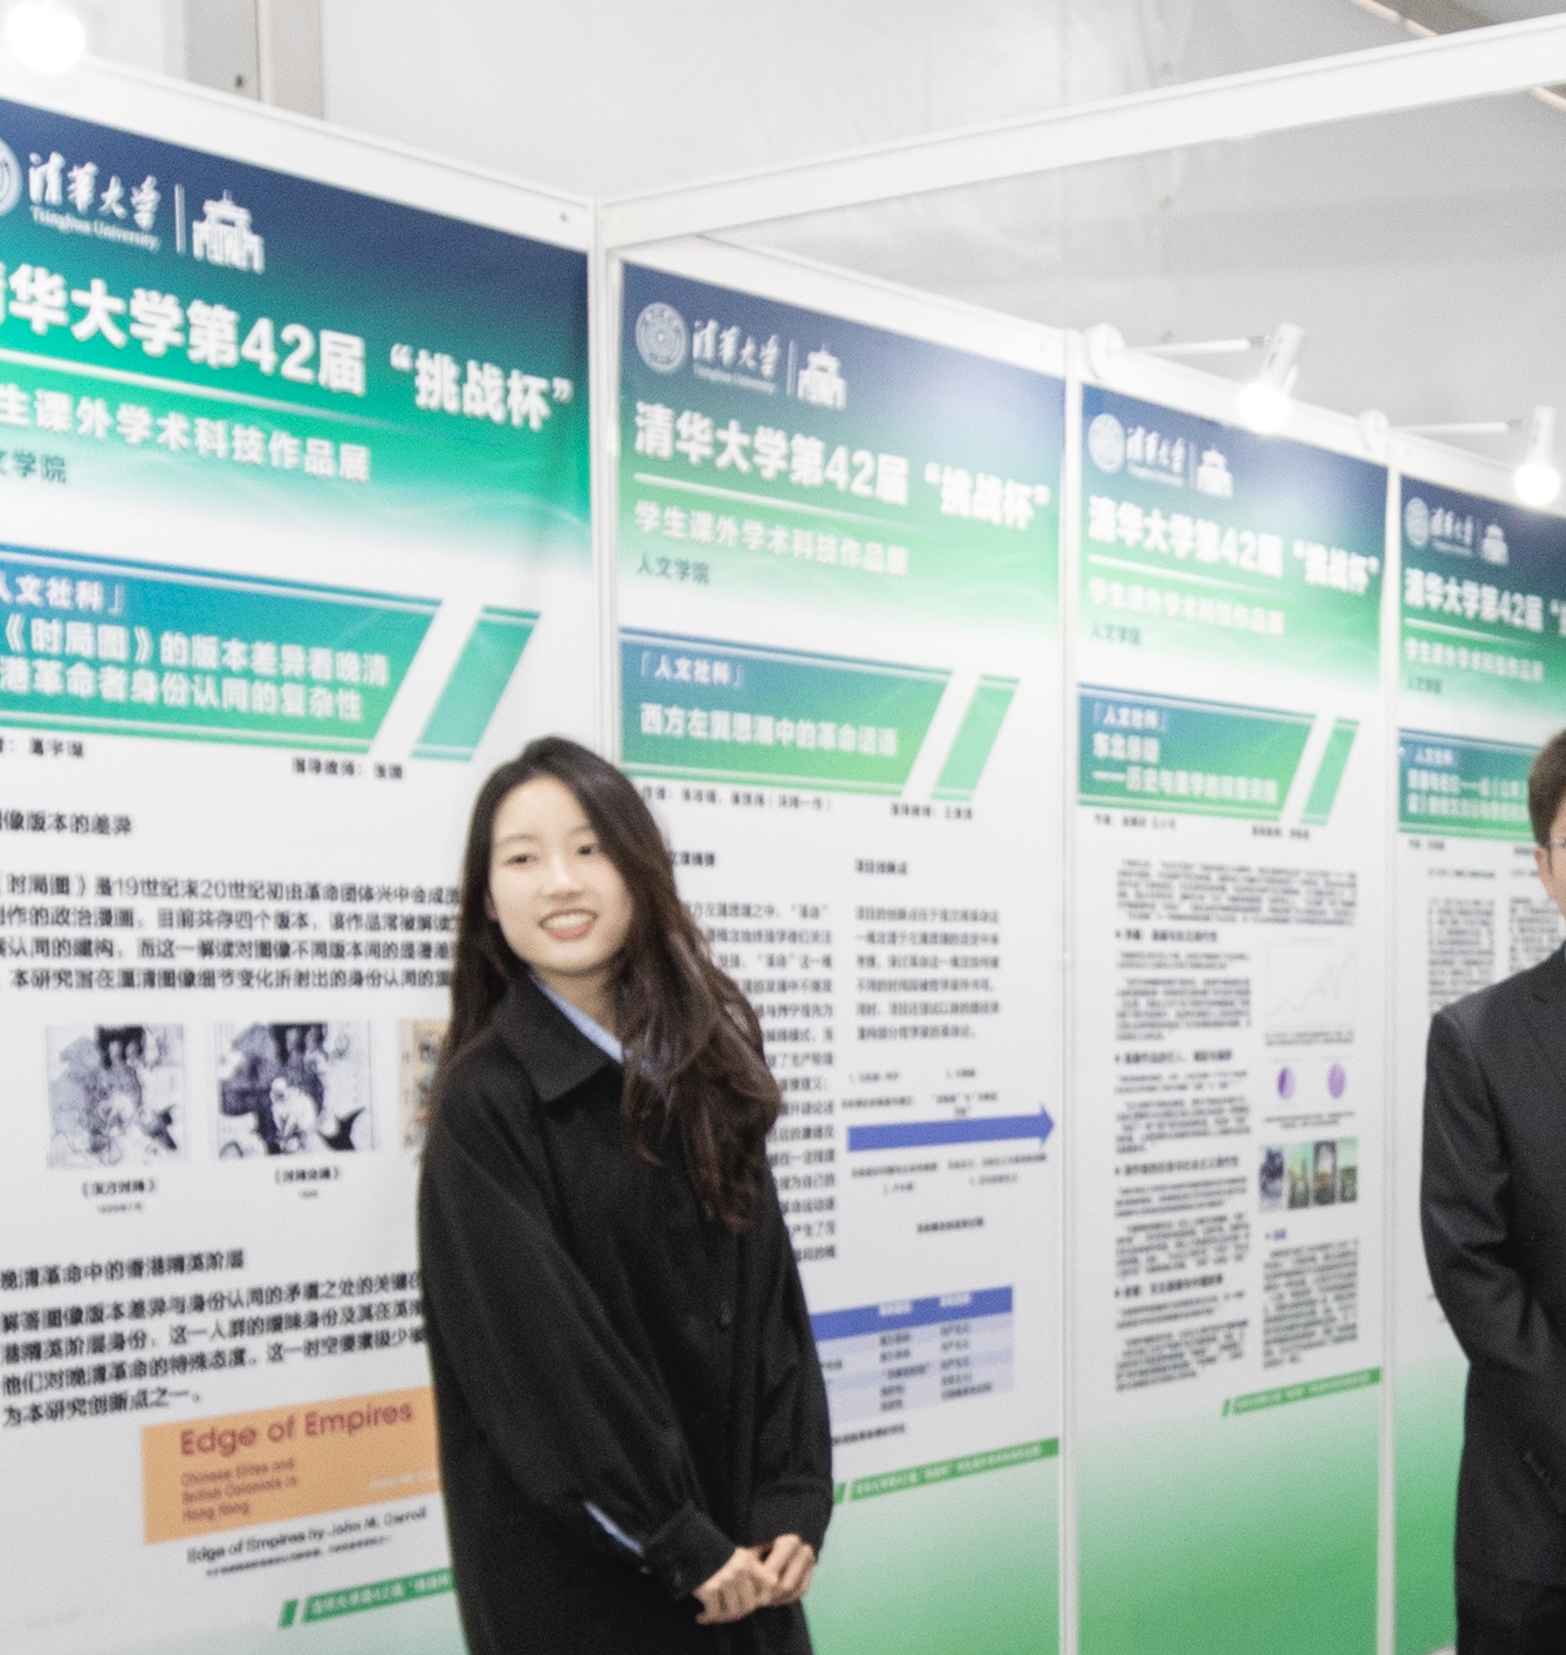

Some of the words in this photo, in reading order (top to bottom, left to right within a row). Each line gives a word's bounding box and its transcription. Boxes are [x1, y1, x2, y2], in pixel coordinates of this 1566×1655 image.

[180, 1427, 258, 1458] Edge
[267, 1413, 295, 1444] of
[304, 1402, 414, 1438] Empires
